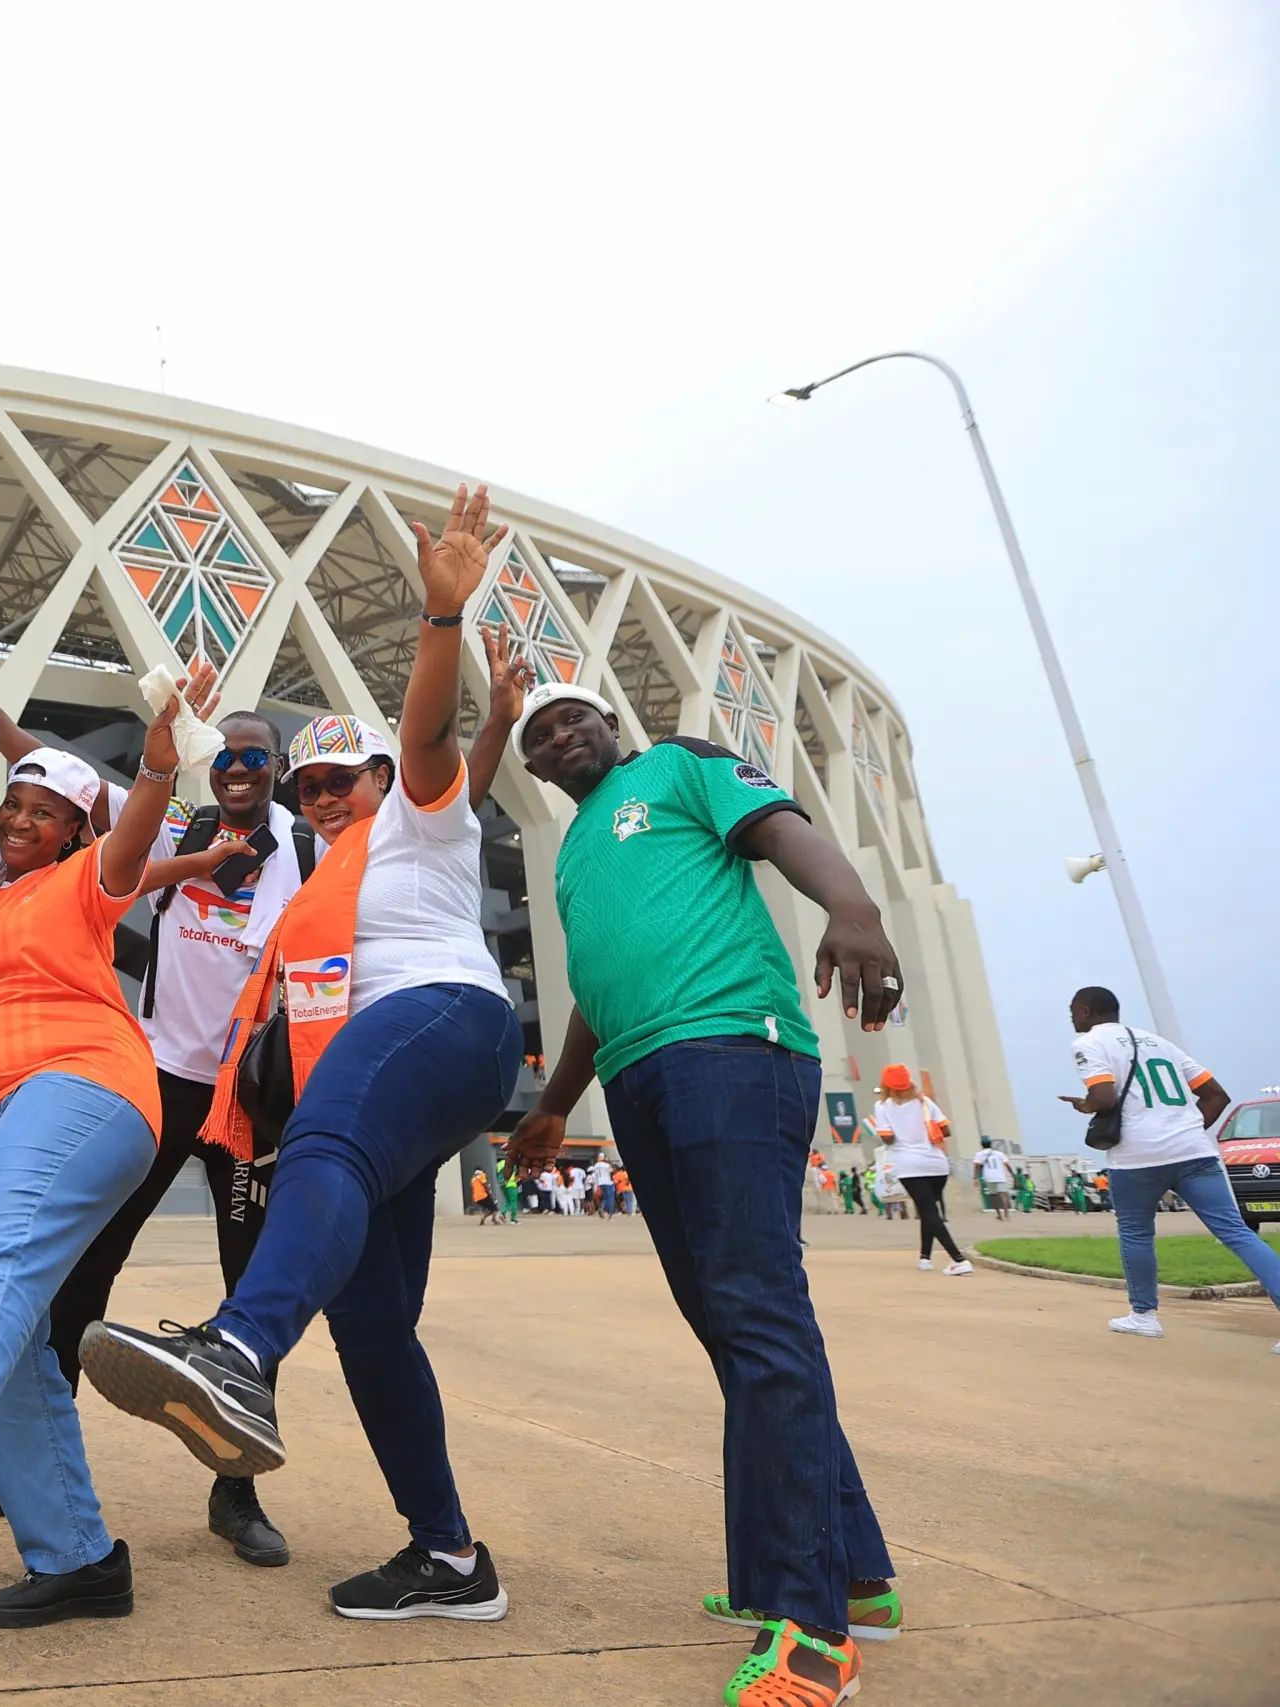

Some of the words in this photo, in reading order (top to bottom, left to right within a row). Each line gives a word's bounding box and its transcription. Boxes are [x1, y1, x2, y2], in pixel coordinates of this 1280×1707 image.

[179, 926, 248, 952] TotalEnerg
[292, 1003, 347, 1019] TotalEnergies
[1129, 1058, 1188, 1108] 10
[231, 1156, 250, 1223] ARMANI
